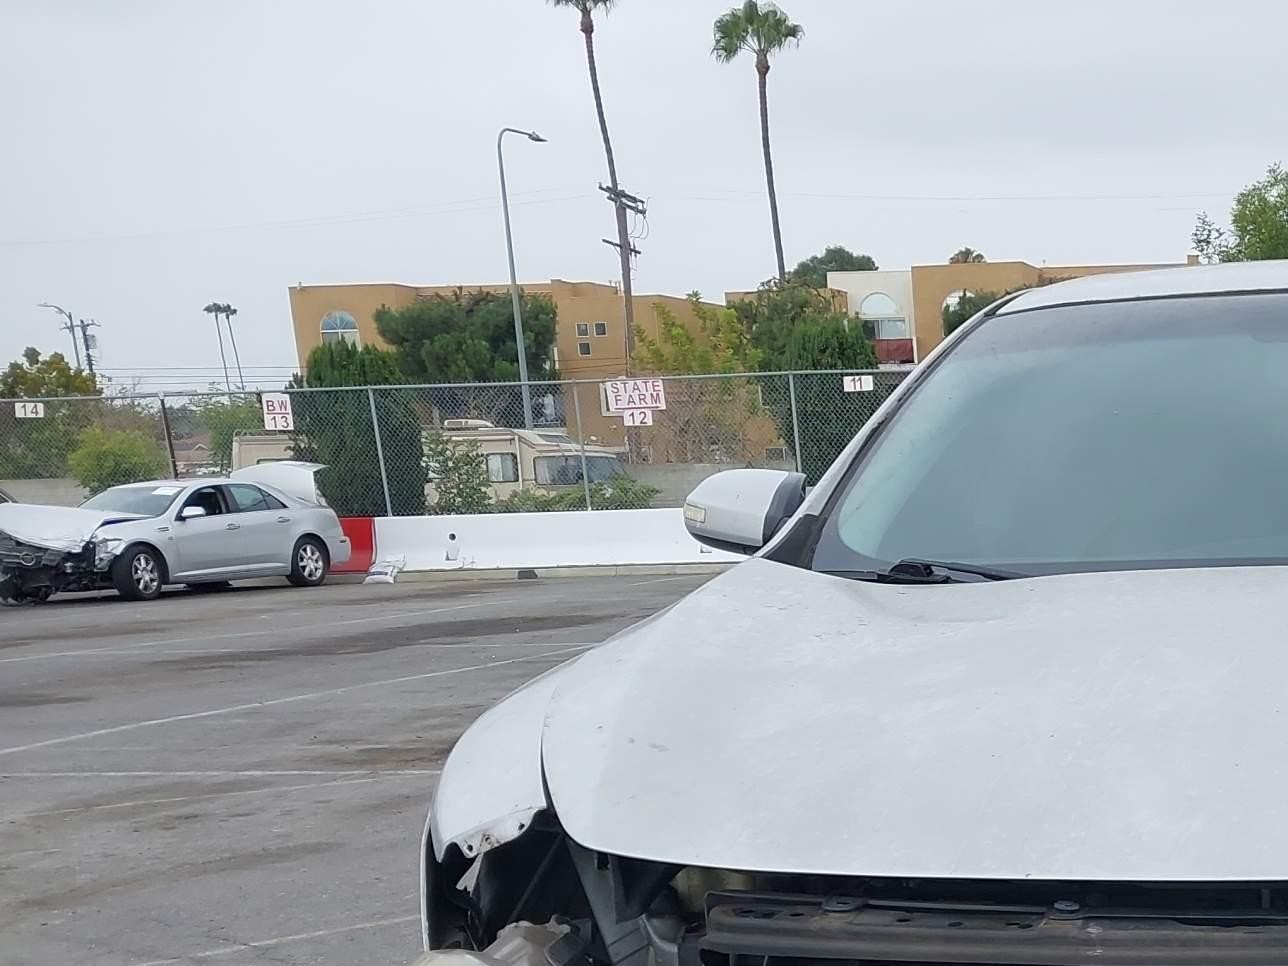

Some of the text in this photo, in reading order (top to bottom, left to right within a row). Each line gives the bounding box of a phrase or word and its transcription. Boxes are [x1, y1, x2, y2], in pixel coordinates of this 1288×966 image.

[610, 380, 662, 394] STATE
[850, 376, 863, 390] 11
[265, 399, 288, 412] BW
[614, 392, 661, 406] FARM
[20, 403, 40, 417] 14
[270, 415, 290, 429] 13
[628, 411, 648, 425] 12
